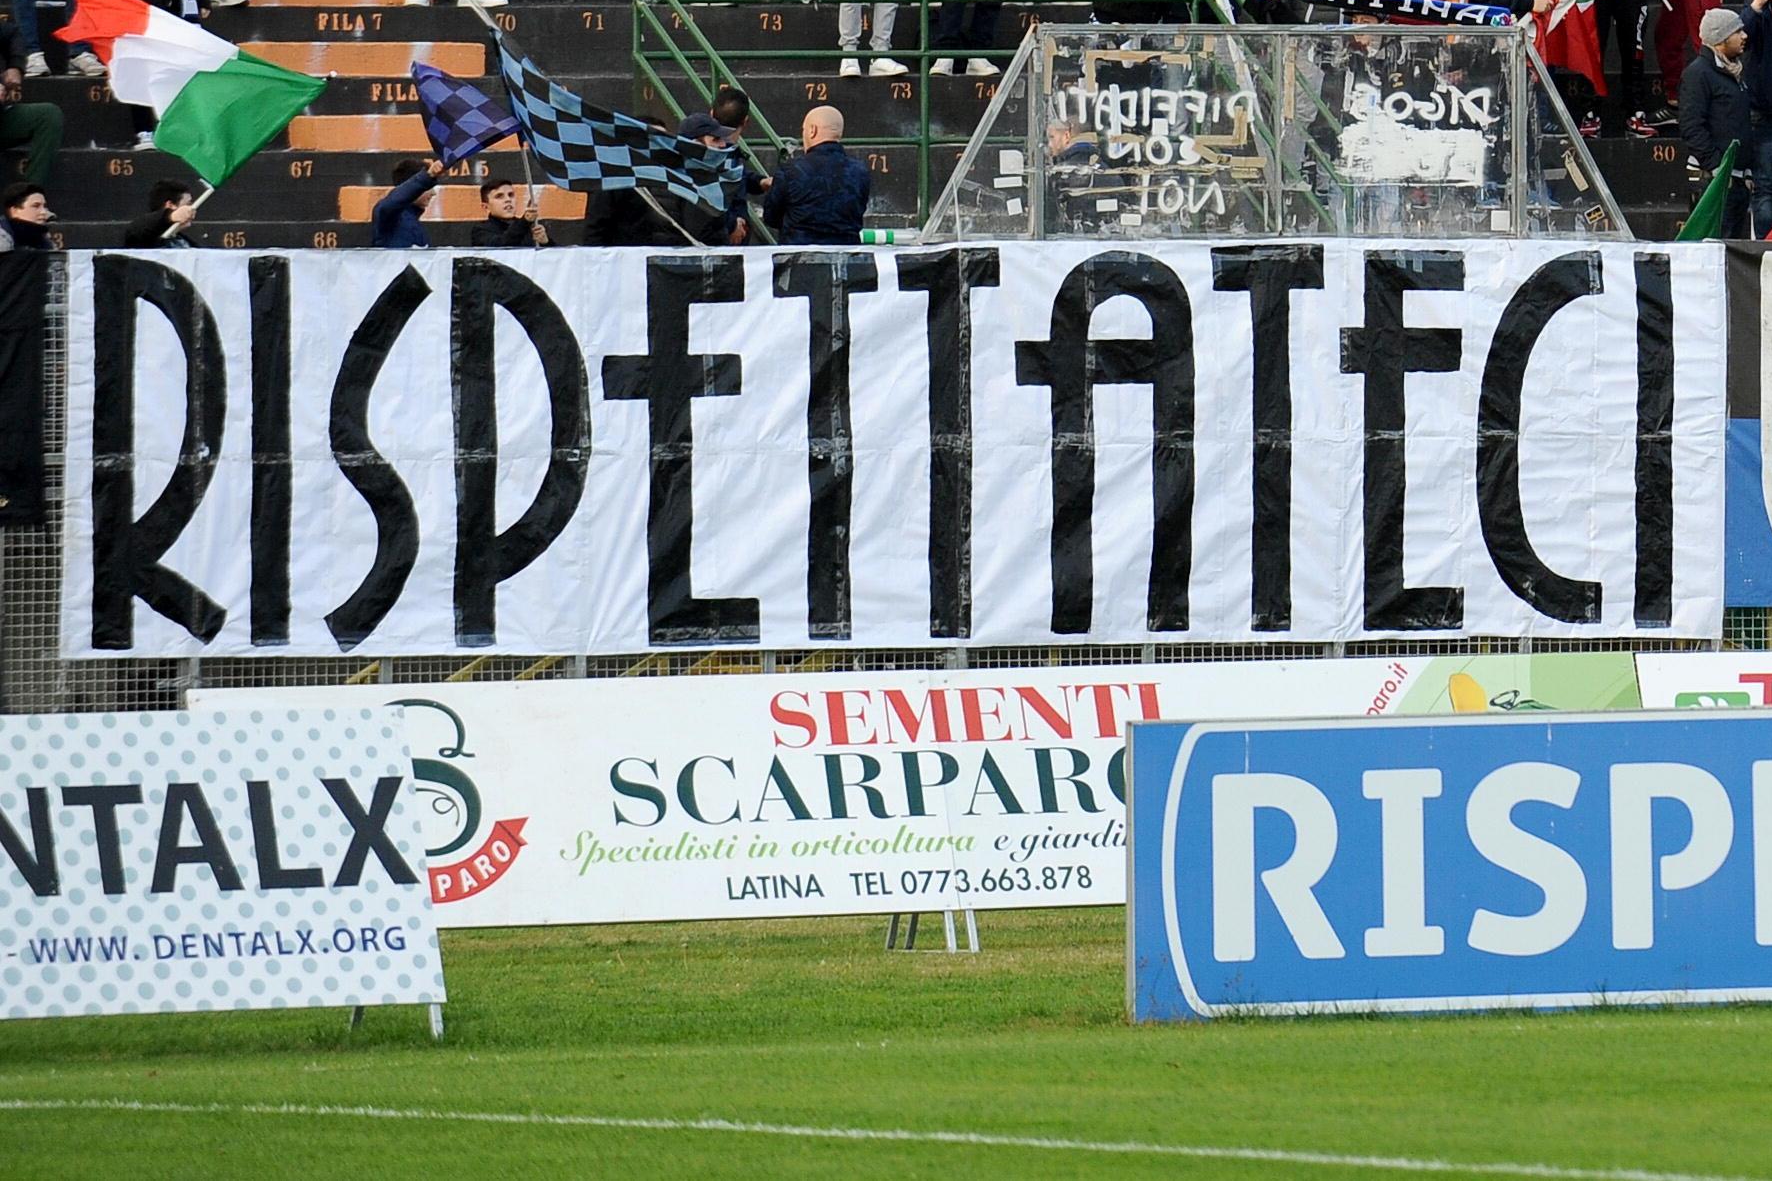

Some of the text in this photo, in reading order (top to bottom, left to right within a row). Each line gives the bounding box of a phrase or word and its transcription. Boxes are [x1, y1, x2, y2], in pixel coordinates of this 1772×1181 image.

[318, 13, 383, 31] FILA 7
[582, 12, 605, 31] 71
[759, 13, 783, 31] 73
[371, 83, 419, 101] FILA
[805, 83, 829, 101] 72
[890, 82, 913, 100] 73
[1653, 144, 1676, 162] 80
[109, 160, 133, 176] 65
[290, 161, 313, 177] 67
[868, 154, 889, 173] 71
[223, 232, 247, 249] 65
[313, 232, 338, 249] 66
[91, 244, 1675, 651] RISPETTATECI
[769, 682, 1162, 748] SEMENTI
[560, 829, 738, 876] Specialisti
[746, 833, 785, 859] in
[790, 824, 977, 857] orticoltura
[993, 834, 1013, 851] e
[726, 865, 1093, 901] LATINA TEL 0773.663.878
